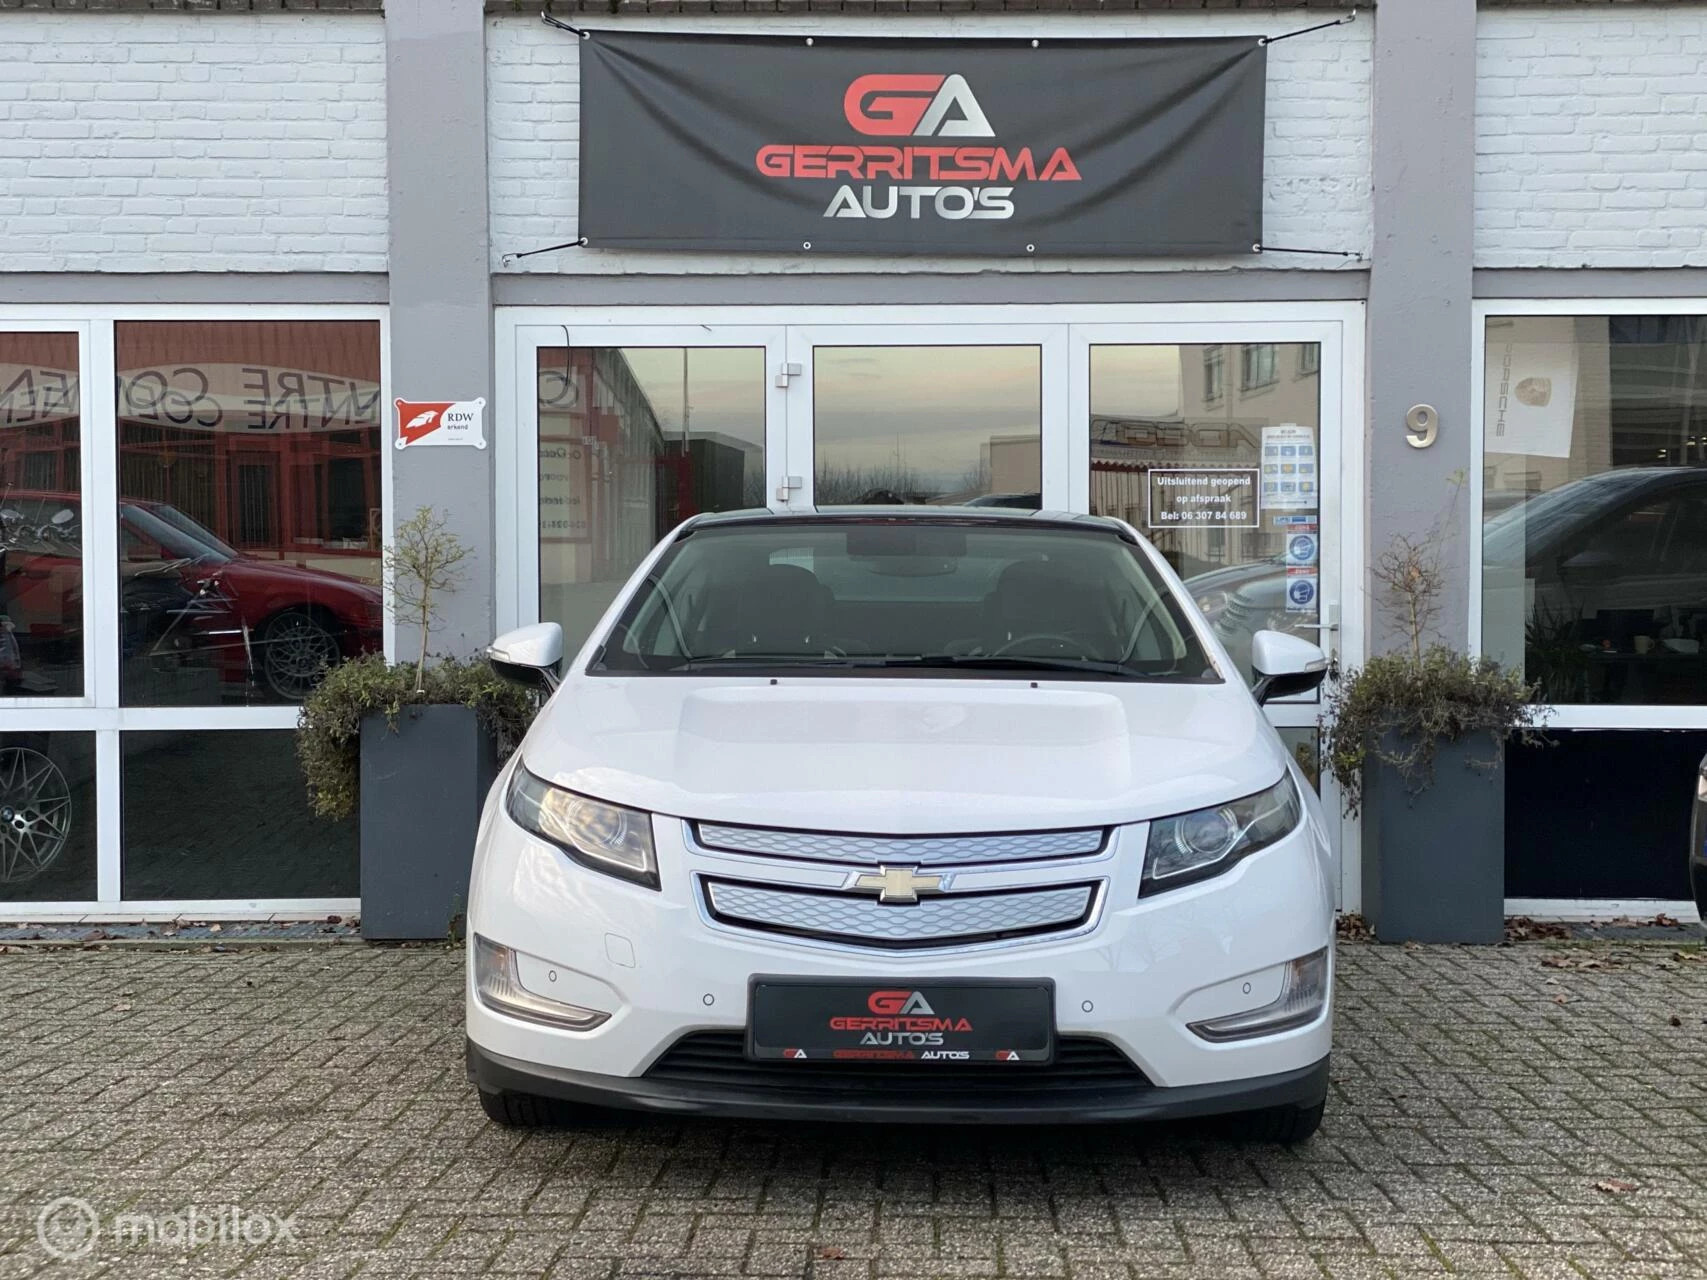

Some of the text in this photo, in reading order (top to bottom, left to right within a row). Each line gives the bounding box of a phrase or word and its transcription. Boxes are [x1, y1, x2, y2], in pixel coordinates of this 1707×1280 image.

[843, 73, 995, 136] GA
[757, 145, 1082, 181] GERRITSMA
[823, 185, 1015, 220] AUTO'S
[447, 413, 474, 422] RDW
[1406, 403, 1438, 449] 9
[1157, 476, 1251, 487] Uitsluitend geopend
[1176, 494, 1231, 504] op afspraak
[1161, 511, 1247, 520] Bel: 06 307 84 689
[867, 991, 935, 1015] GA
[830, 1017, 973, 1032] GERRITSMA
[859, 1032, 944, 1045] AUTO'S
